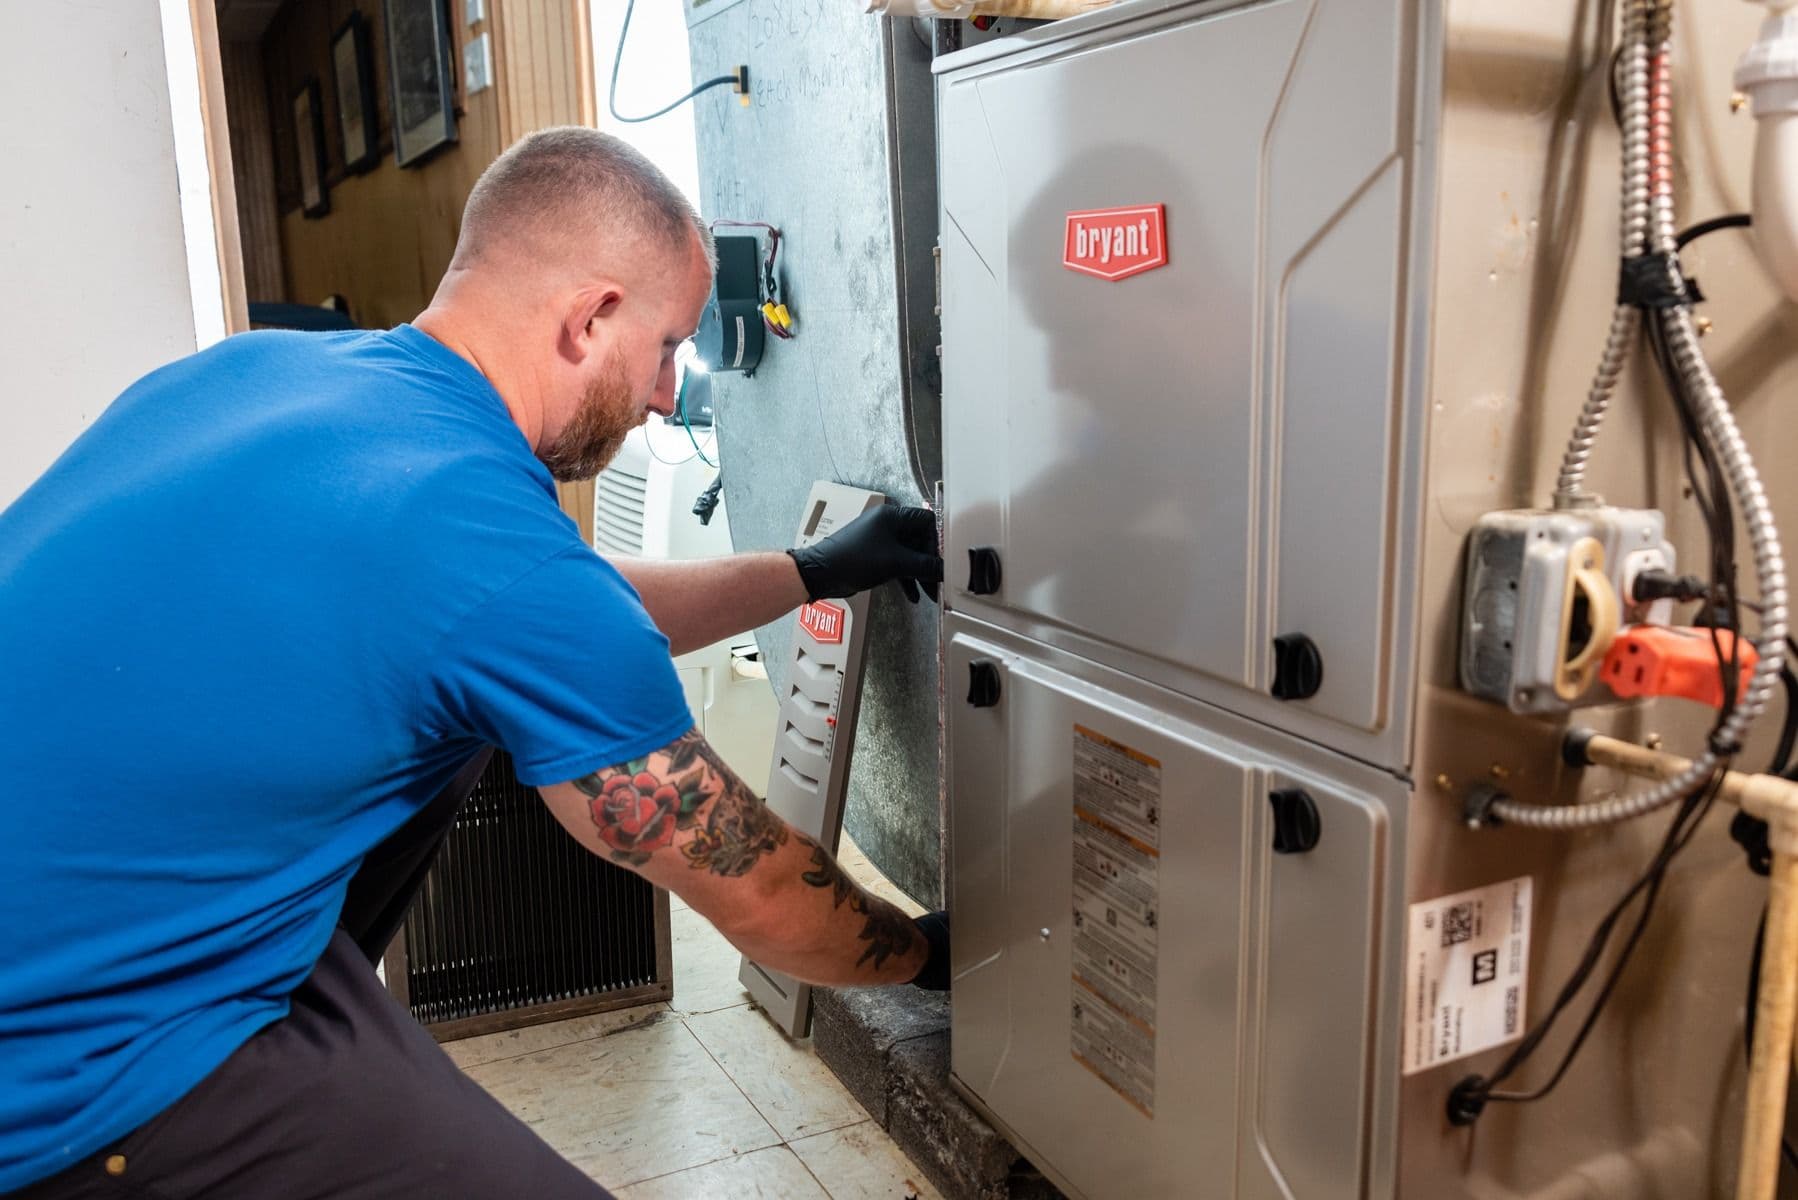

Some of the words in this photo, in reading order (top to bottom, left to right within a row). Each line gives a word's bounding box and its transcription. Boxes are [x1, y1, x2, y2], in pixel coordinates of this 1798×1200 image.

[1076, 219, 1149, 263] bryant
[804, 603, 836, 635] bryant
[1476, 953, 1495, 982] M
